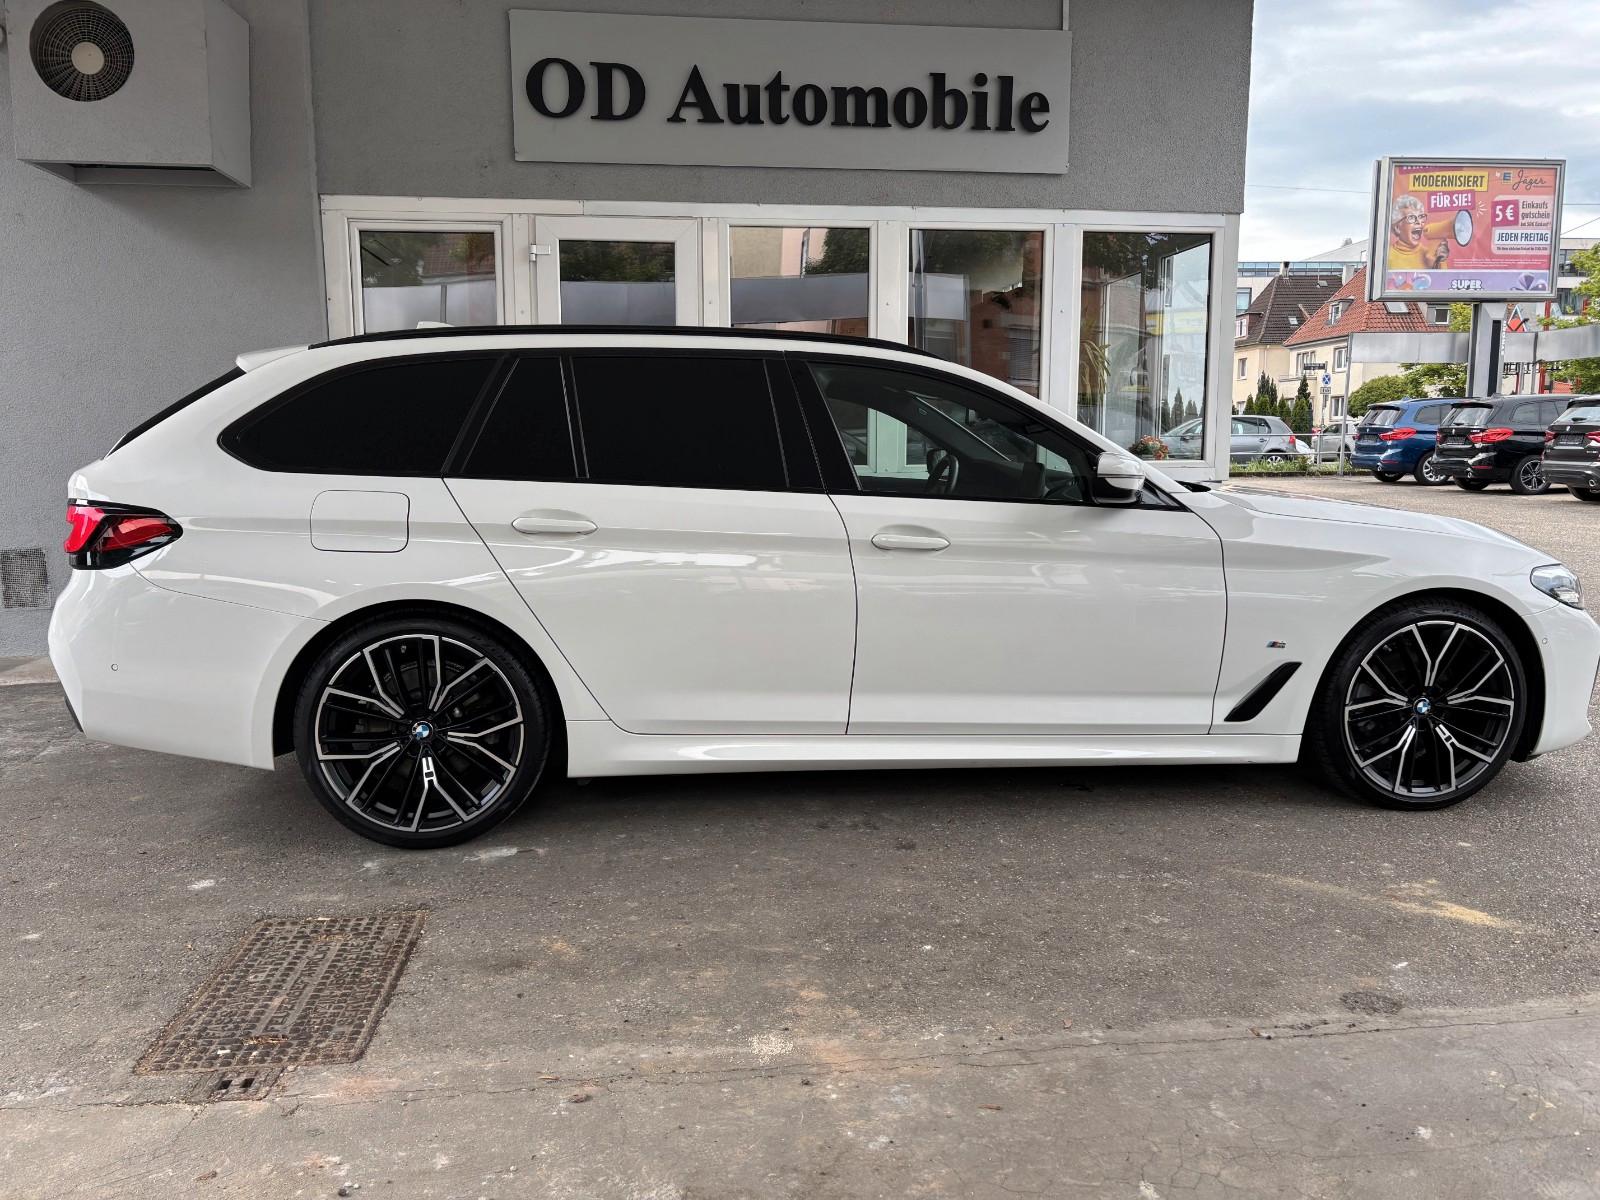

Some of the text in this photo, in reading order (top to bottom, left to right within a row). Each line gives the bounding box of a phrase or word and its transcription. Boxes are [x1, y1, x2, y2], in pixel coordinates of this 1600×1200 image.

[525, 57, 1050, 133] OD Automobile
[1412, 174, 1485, 188] MODERNISIERT
[1430, 192, 1472, 208] FÜR SIE!
[1495, 204, 1515, 222] 5 €
[1521, 210, 1551, 220] gutschein
[1497, 232, 1549, 242] JEDEN FREITAG
[1451, 279, 1482, 289] SUPER
